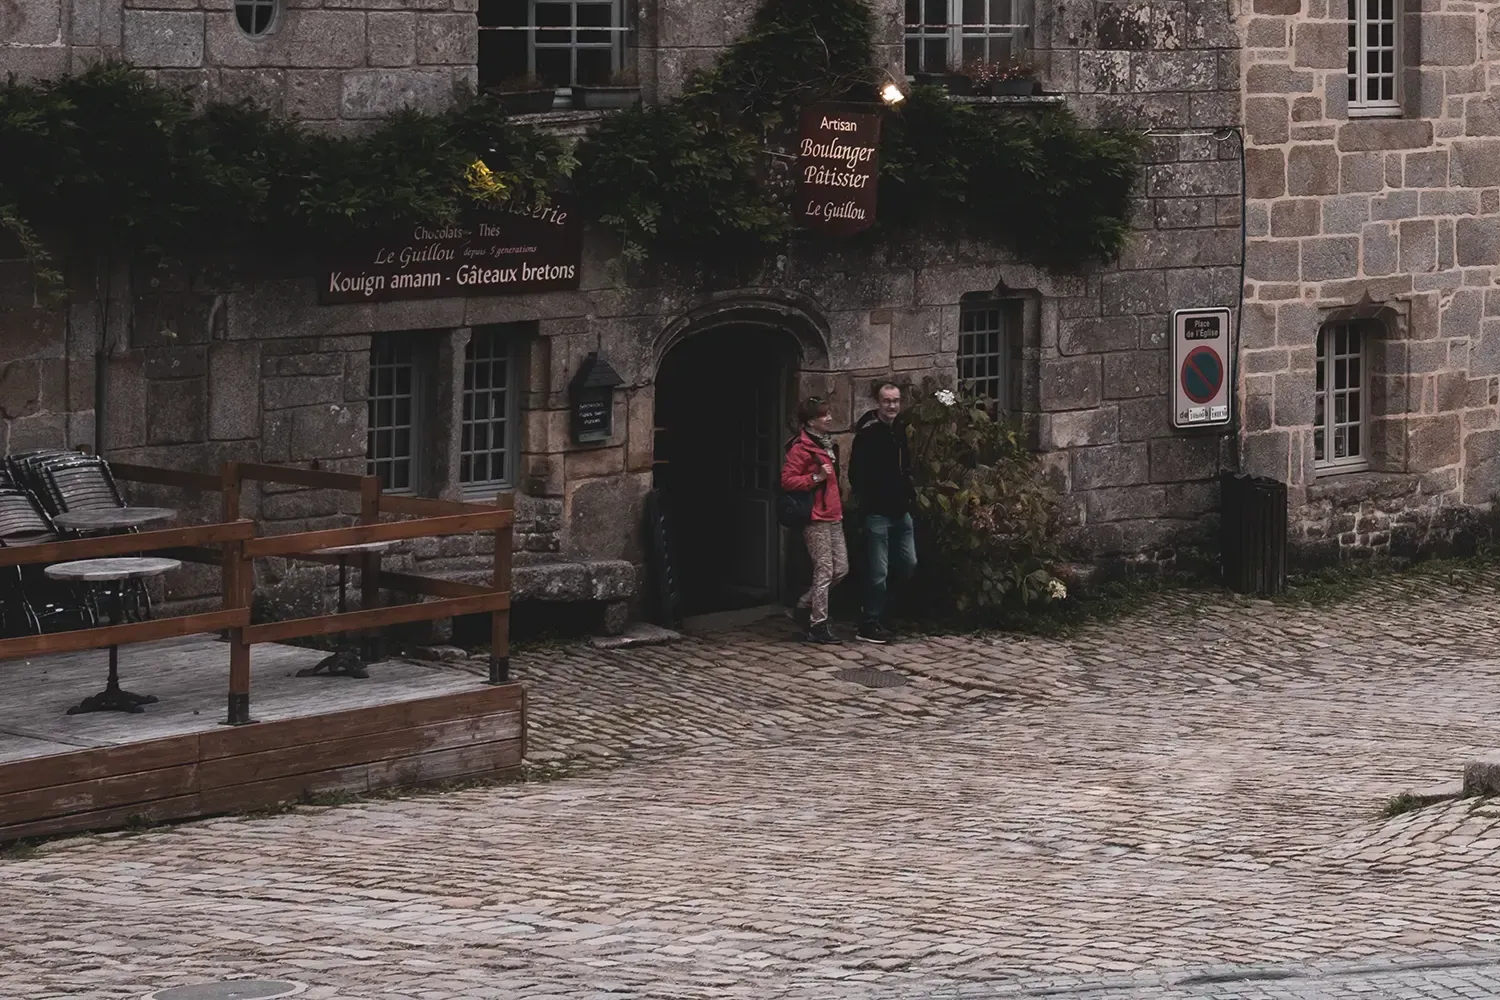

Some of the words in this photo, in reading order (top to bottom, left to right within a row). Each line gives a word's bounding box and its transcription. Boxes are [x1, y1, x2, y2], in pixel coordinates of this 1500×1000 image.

[820, 116, 857, 132] Artisan
[800, 137, 875, 169] Boulanger
[804, 165, 870, 189] Pâtissier
[805, 200, 821, 216] Le
[823, 201, 866, 222] Guillou
[414, 225, 463, 241] Chocolats
[374, 248, 394, 265] Le
[399, 242, 455, 269] Guillou
[463, 247, 486, 258] depuis
[329, 271, 385, 296] Kouign
[390, 272, 441, 289] amann
[456, 264, 517, 286] Gâteaux
[522, 262, 575, 281] bretons
[1194, 319, 1211, 328] Place
